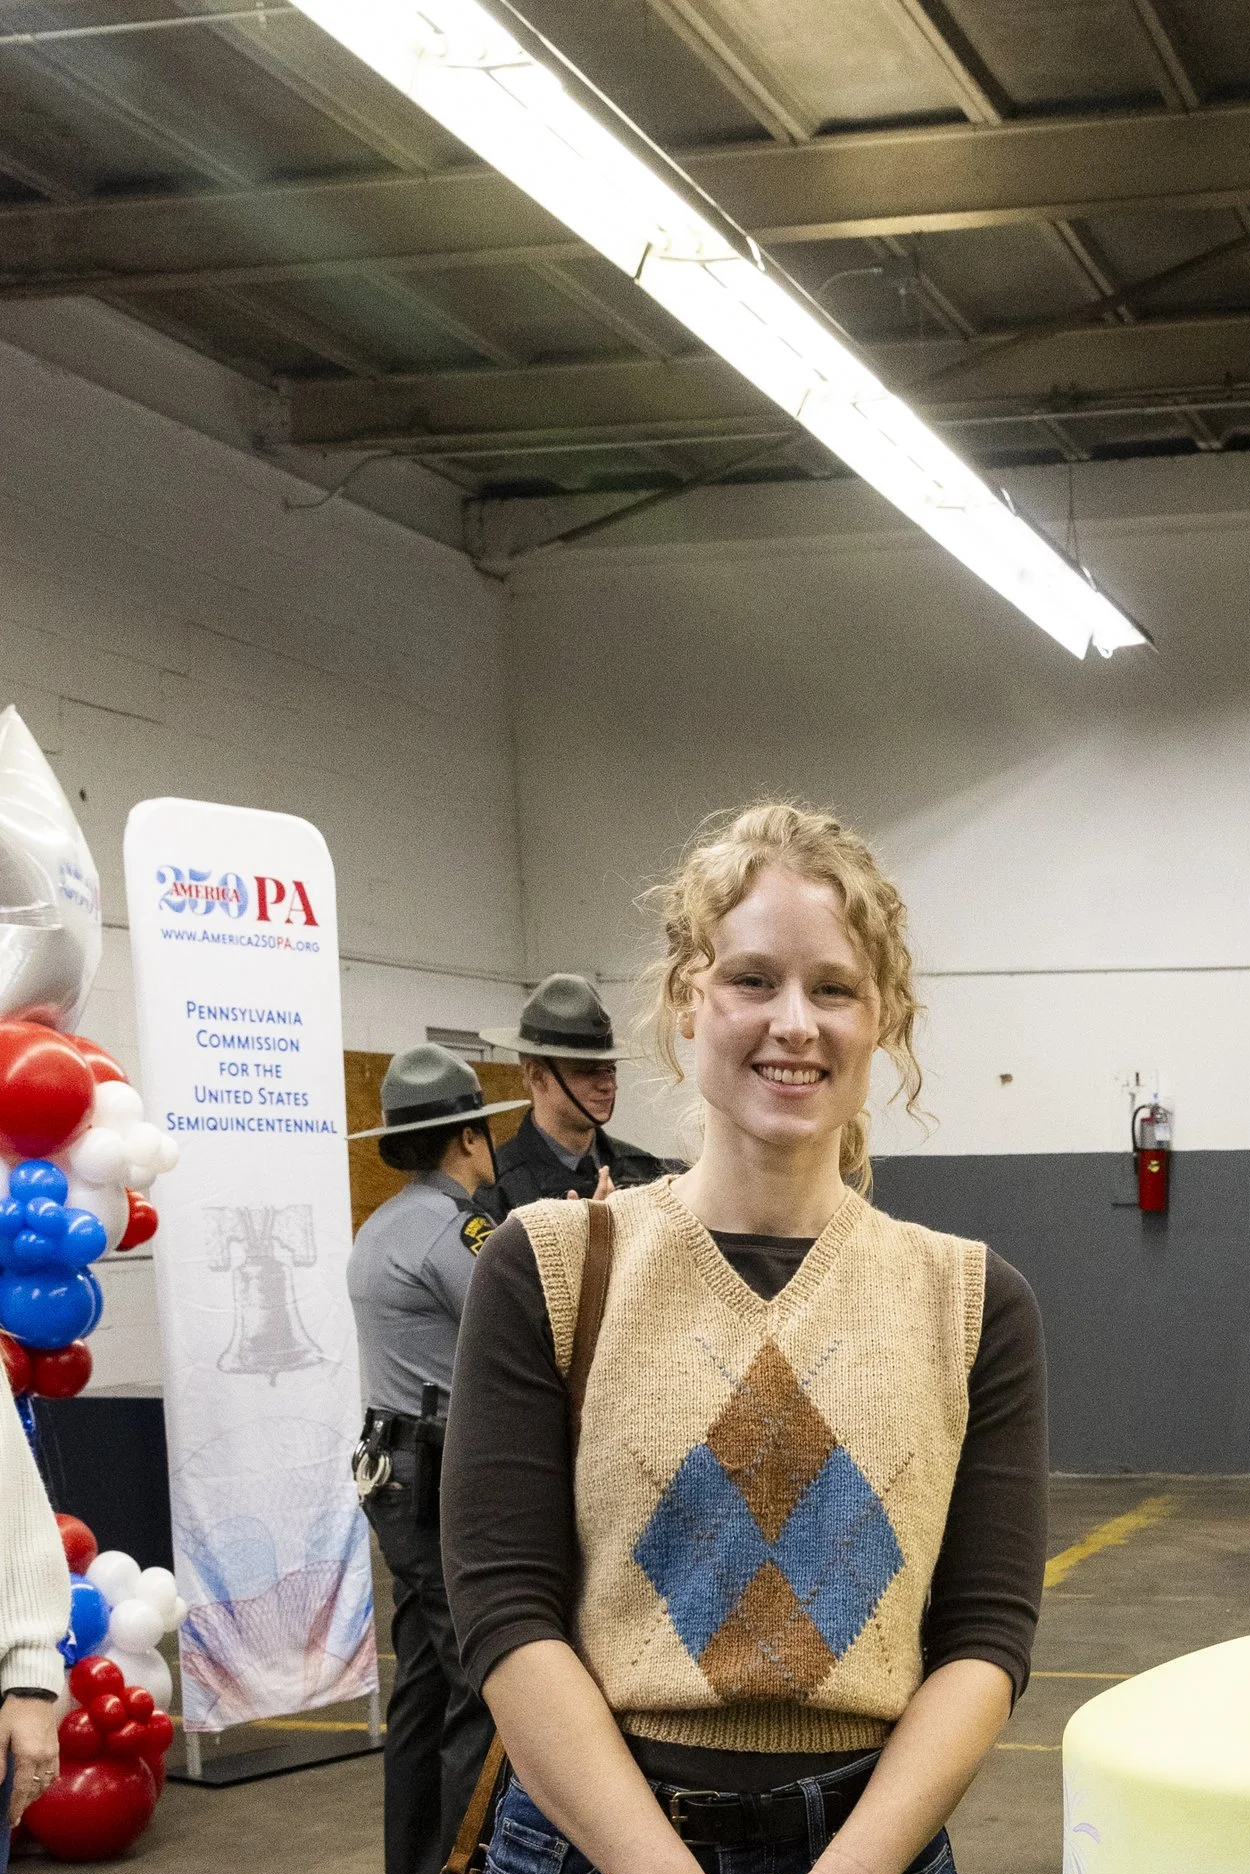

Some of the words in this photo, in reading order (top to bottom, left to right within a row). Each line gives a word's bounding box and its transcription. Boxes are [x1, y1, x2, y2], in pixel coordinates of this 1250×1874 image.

[156, 865, 249, 920] 250
[253, 876, 320, 928] PA
[169, 882, 240, 903] AMERICA
[219, 1062, 249, 1077] FOR
[254, 1063, 283, 1078] THE
